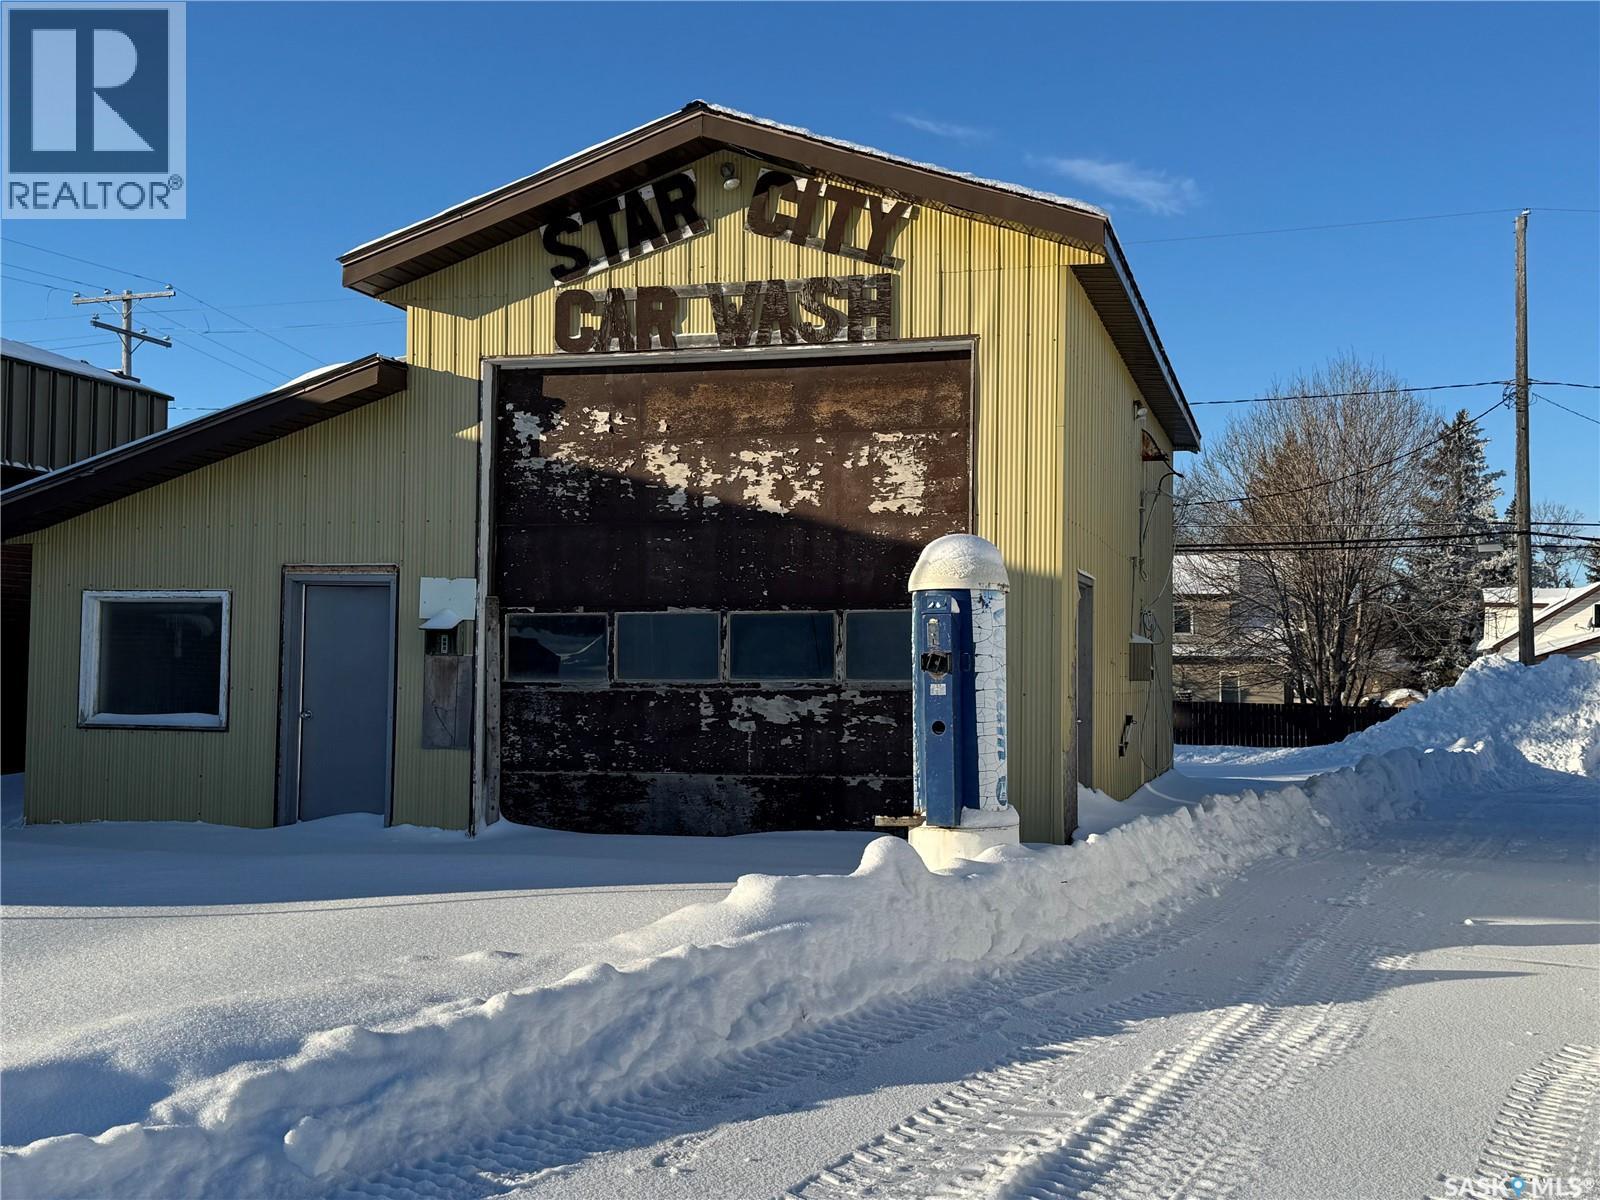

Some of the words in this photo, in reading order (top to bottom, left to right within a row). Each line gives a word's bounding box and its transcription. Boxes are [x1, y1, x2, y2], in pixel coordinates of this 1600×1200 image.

[541, 169, 708, 285] STAR
[744, 169, 921, 270] CITY
[554, 285, 679, 353] CAR
[706, 273, 893, 349] WASH
